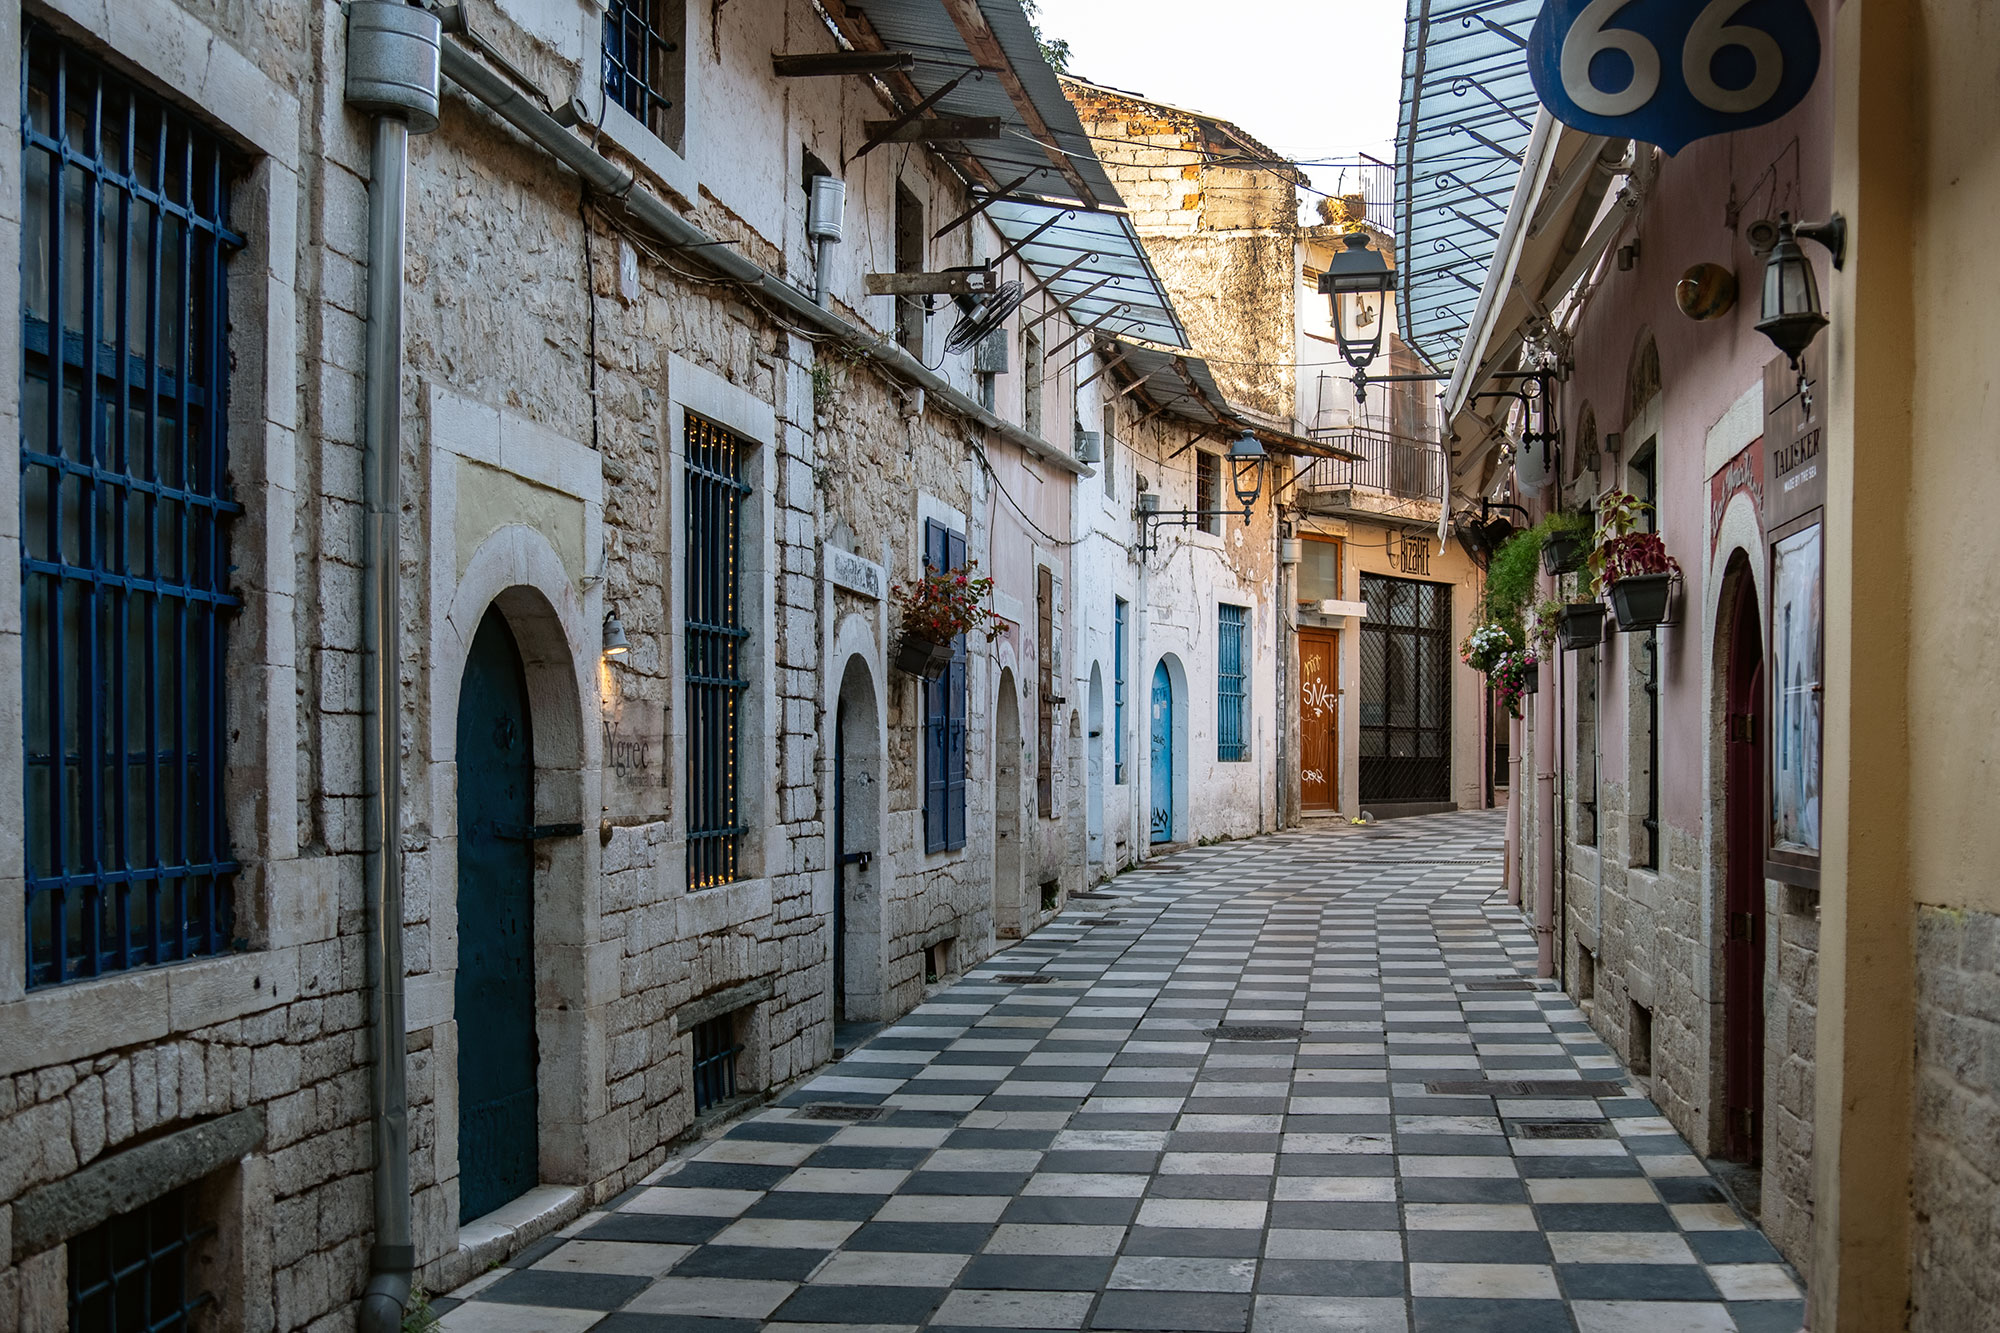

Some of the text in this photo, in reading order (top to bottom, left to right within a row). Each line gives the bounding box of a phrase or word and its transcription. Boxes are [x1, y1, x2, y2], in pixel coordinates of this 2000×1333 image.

[1561, 0, 1783, 117] 66
[1774, 427, 1820, 479] TALISKER
[603, 720, 650, 778] Ygrec
